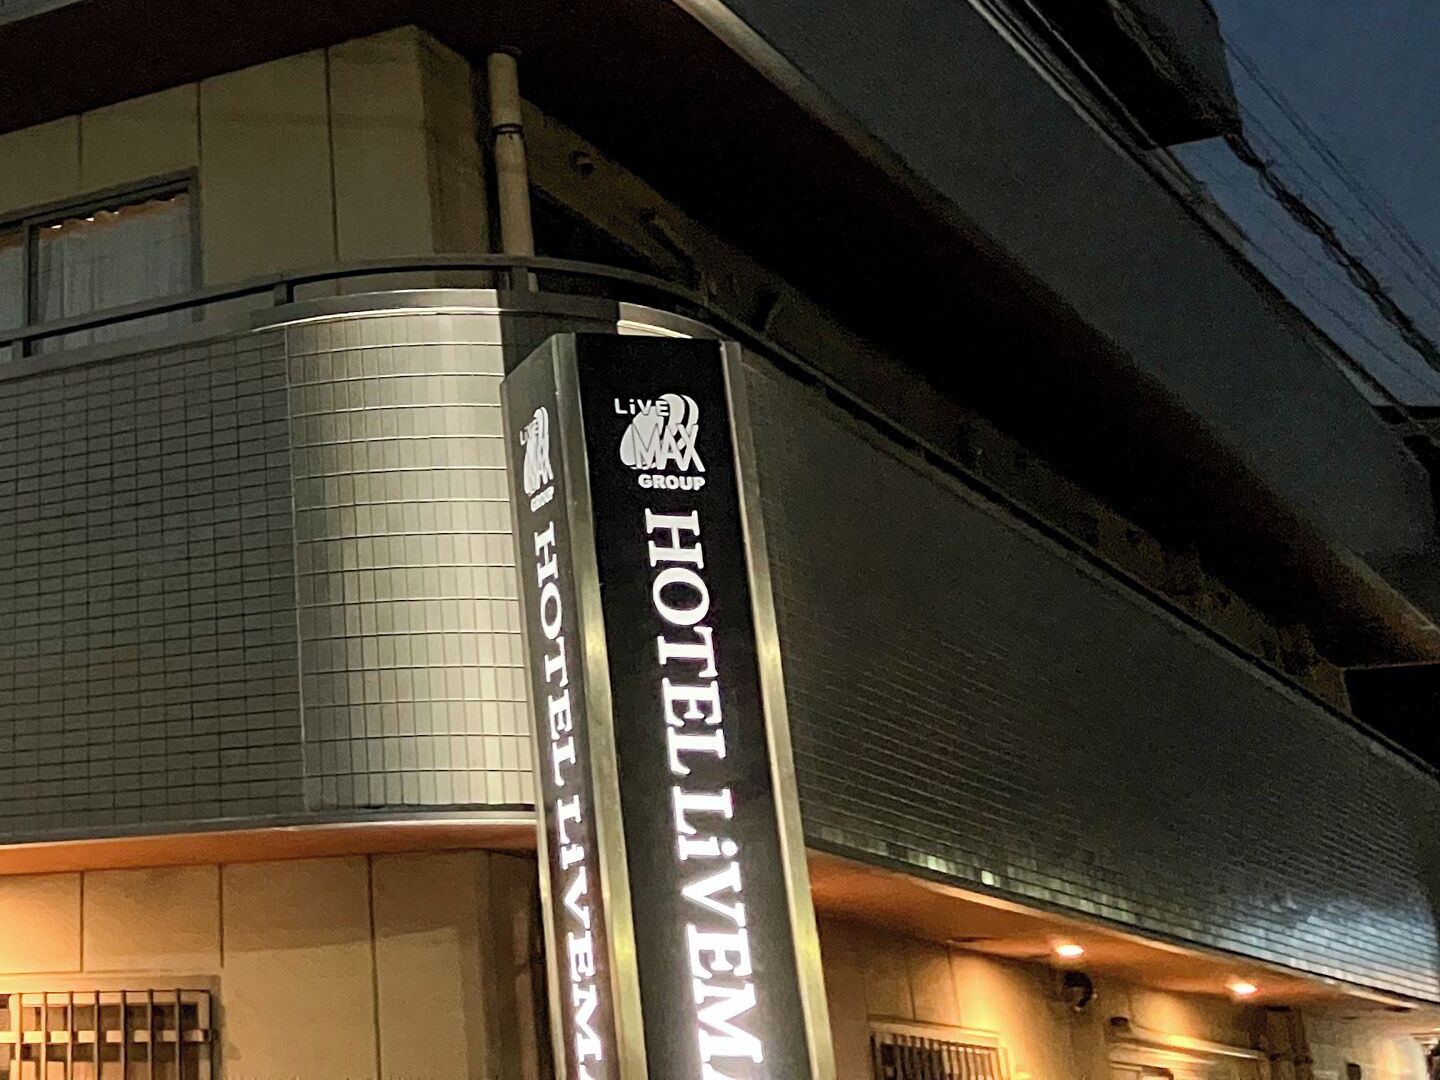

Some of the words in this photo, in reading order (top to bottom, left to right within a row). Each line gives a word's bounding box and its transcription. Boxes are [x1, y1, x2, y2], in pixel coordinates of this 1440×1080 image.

[614, 397, 670, 417] LiVE
[630, 423, 706, 472] MAX
[638, 473, 706, 491] GROUP
[644, 507, 727, 775] HOTEL
[533, 520, 577, 786] HOTEL
[557, 794, 602, 1080] LiVEM
[672, 785, 764, 1080] LiVEM
